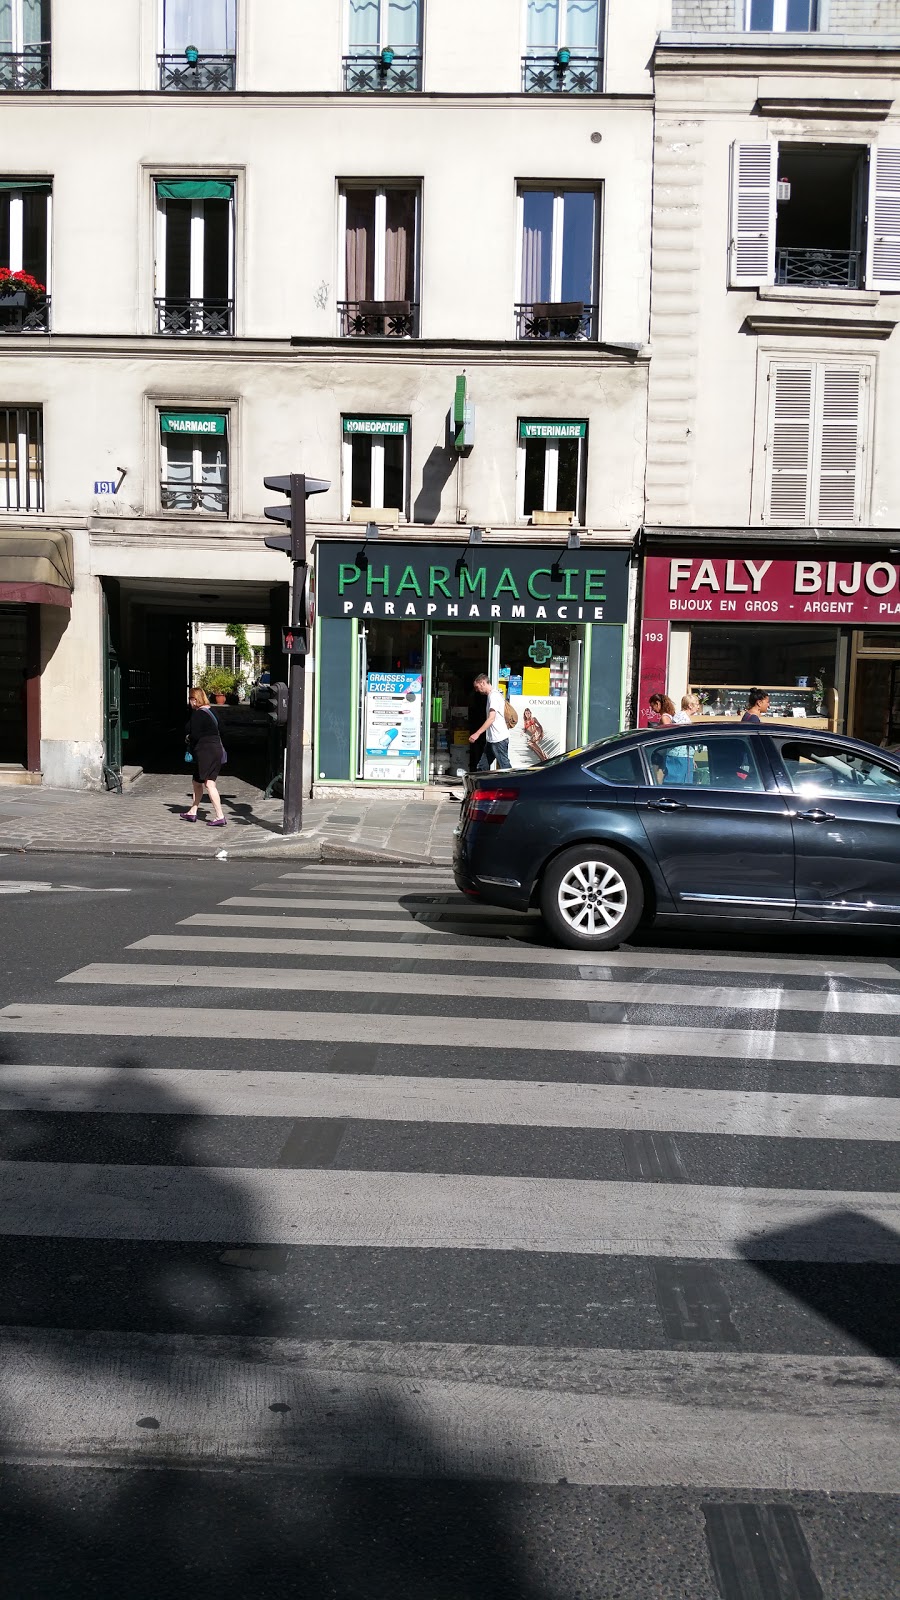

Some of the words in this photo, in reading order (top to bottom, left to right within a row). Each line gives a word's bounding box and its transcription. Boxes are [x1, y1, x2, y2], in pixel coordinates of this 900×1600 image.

[168, 419, 217, 432] PHARMACIE
[346, 420, 405, 433] HOMEOPATHIE
[525, 425, 581, 436] VETERINAIRE
[97, 482, 113, 494] 191
[669, 558, 773, 592] FALY
[338, 563, 607, 601] PHARMACIE
[343, 601, 604, 620] PARAPHARMACIE
[669, 599, 713, 611] BIJOUX
[720, 600, 736, 611] EN
[745, 600, 779, 612] GROS
[803, 601, 854, 613] ARGENT
[645, 633, 663, 642] 193
[369, 673, 406, 683] GRAISSES
[369, 682, 396, 692] EXCÈS
[398, 684, 404, 692] ?
